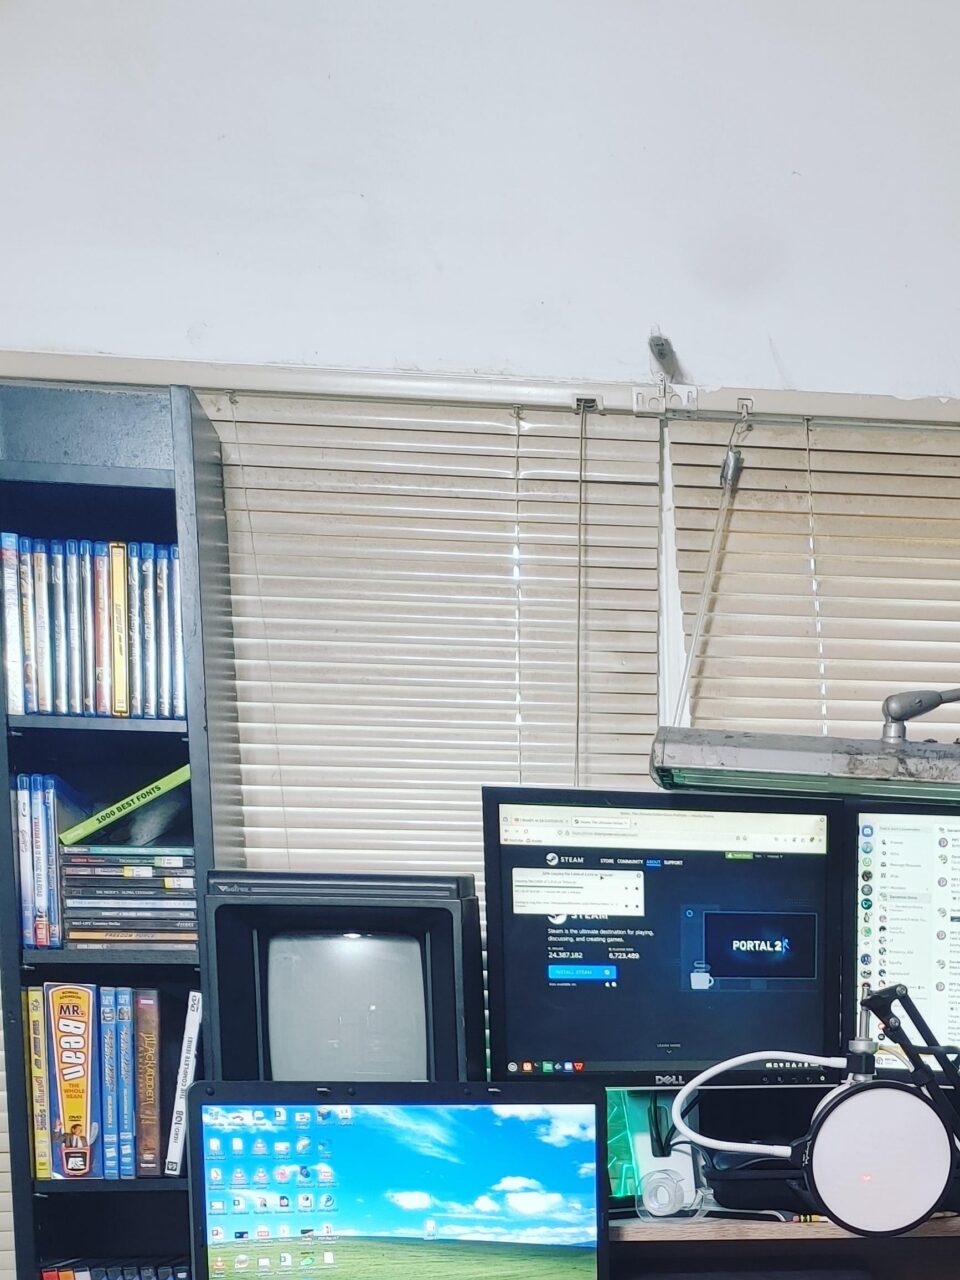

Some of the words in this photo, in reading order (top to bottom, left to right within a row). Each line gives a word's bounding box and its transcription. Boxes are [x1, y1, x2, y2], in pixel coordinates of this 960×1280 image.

[95, 809, 116, 825] 1000
[116, 798, 136, 813] BEST
[136, 784, 162, 802] FONTS
[732, 940, 773, 951] PORTAL
[774, 940, 782, 951] 2
[58, 1003, 85, 1017] MR.
[57, 1017, 88, 1082] Bean
[180, 1055, 190, 1088] COMPLETE
[655, 1075, 685, 1085] DELL
[174, 1110, 184, 1126] 108
